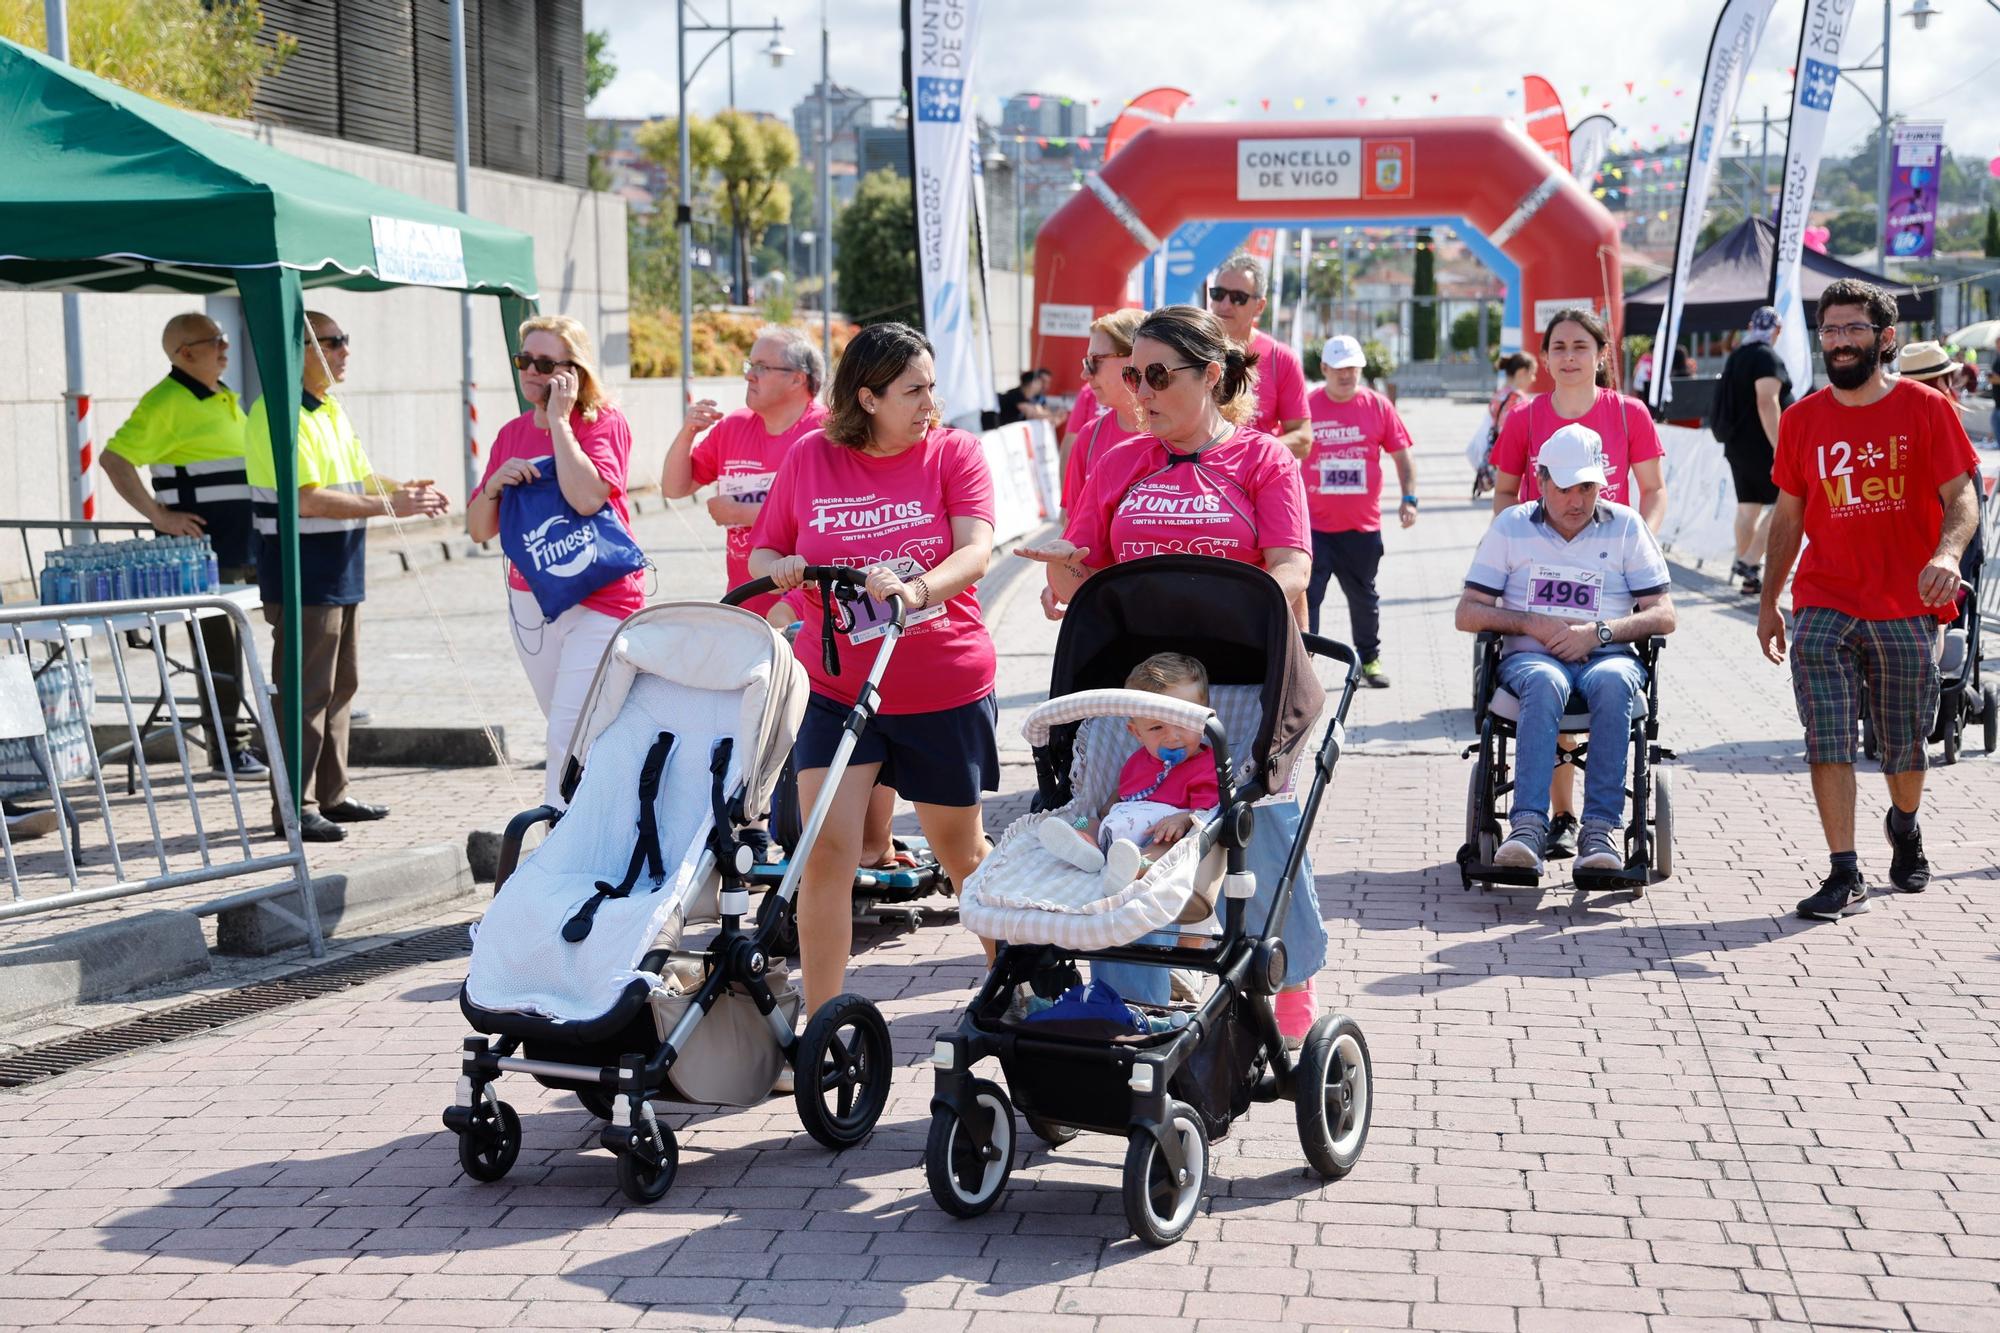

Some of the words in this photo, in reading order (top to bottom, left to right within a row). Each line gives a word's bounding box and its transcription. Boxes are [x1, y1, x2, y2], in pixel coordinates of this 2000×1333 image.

[1246, 151, 1351, 168] CONCELLO
[1259, 172, 1283, 188] DE
[1291, 170, 1339, 187] VIGO
[1786, 165, 1807, 263] GALEGO
[1327, 470, 1359, 485] 494
[841, 533, 866, 541] CONTRA
[526, 525, 594, 571] Fitness
[1538, 580, 1590, 606] 496
